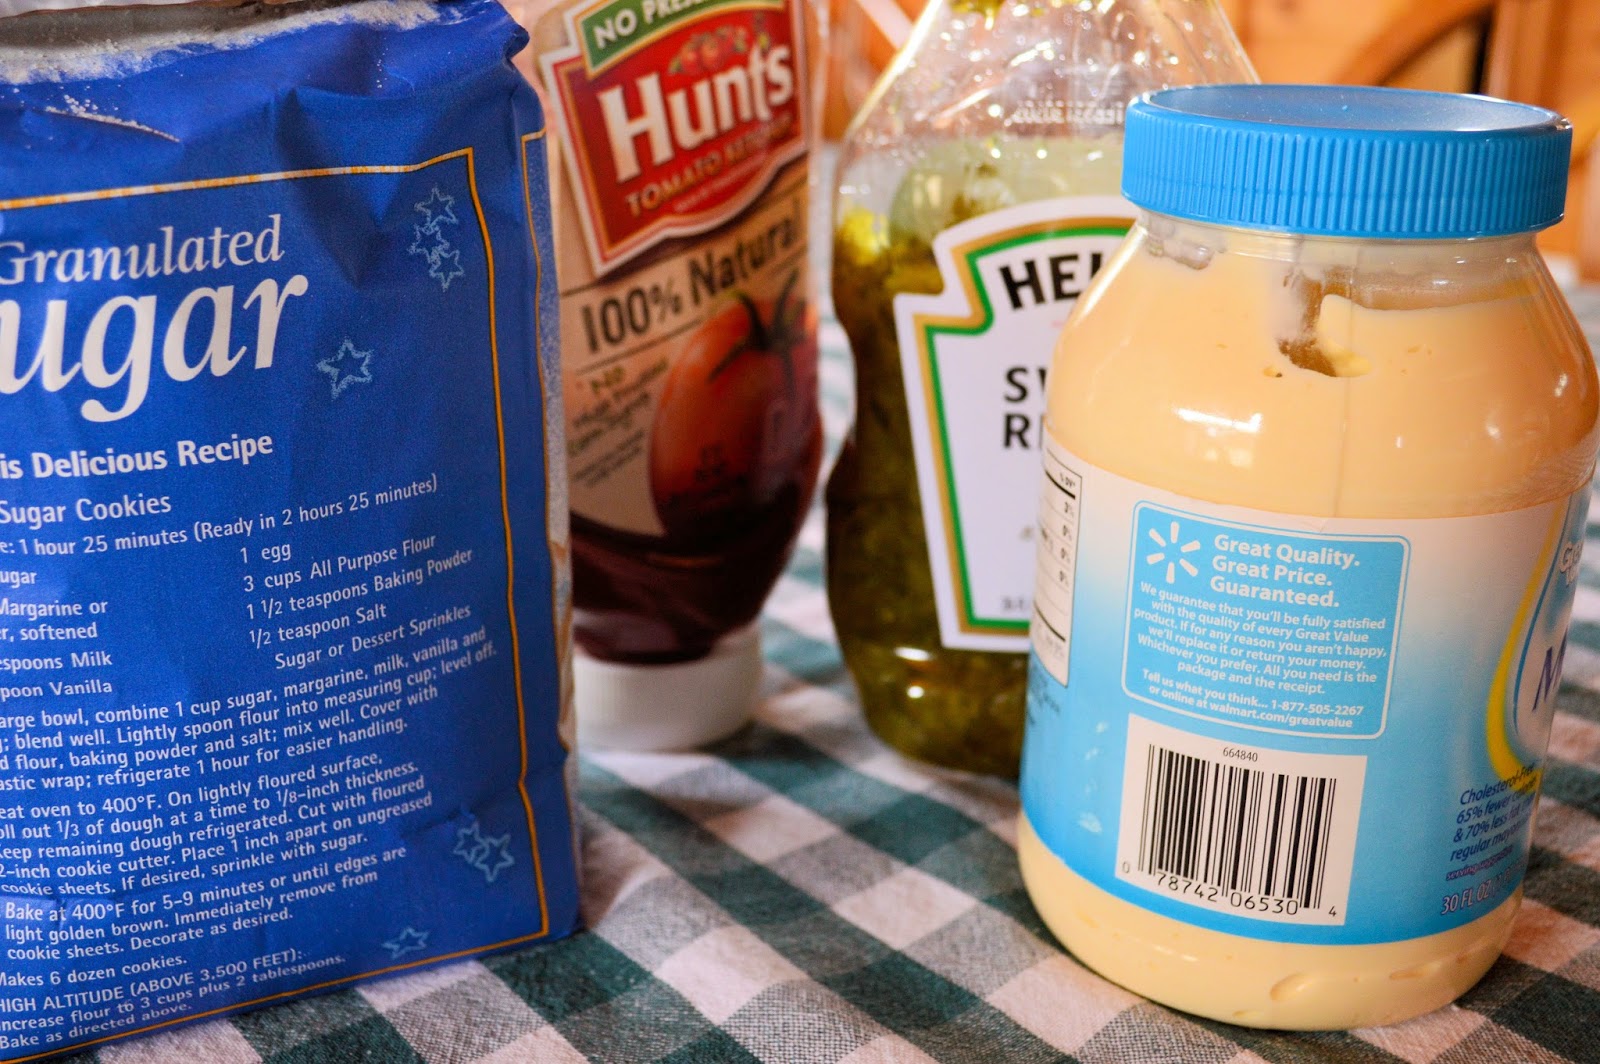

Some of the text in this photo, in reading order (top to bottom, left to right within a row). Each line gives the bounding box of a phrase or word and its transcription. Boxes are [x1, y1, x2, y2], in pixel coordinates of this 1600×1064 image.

[593, 8, 637, 49] NO
[0, 214, 285, 285] Granulated
[580, 276, 683, 352] 100%
[31, 448, 167, 478] Delicious
[177, 434, 273, 466] Recipe
[0, 493, 171, 530] Sugar Cookies
[19, 473, 437, 555] 1 hour 25 minutes (Ready in 2 hours 25 minutes)
[240, 544, 291, 563] 1 egg
[243, 536, 435, 592] 3 cups All Purpose Flour
[1212, 555, 1332, 586] Great Price.
[1214, 534, 1360, 570] Great Quality.
[247, 604, 254, 619] 1
[289, 583, 368, 611] teaspoons
[374, 569, 423, 591] Baking
[427, 550, 472, 575] Powder
[1210, 576, 1339, 607] Guaranteed.
[0, 598, 108, 621] Margarine or
[278, 616, 350, 641] teaspoon
[356, 604, 386, 624] Salt
[1140, 581, 1157, 596] We
[1158, 589, 1217, 612] guarantee
[1219, 603, 1243, 616] that
[1284, 613, 1299, 624] be
[1303, 615, 1331, 629] fully
[1334, 618, 1386, 629] satisfied
[1151, 600, 1369, 642] with the quality of every Great Value
[20, 622, 98, 640] softened
[275, 606, 470, 669] Sugar or Dessert Sprinkles
[1135, 609, 1386, 658] product. If for any reason you aren't happy,
[71, 651, 112, 667] Milk
[1138, 634, 1377, 682] Whichever you prefer. All you need is the
[1176, 635, 1216, 651] replace
[1220, 644, 1227, 653] it
[1231, 648, 1243, 656] or
[1247, 651, 1284, 663] return
[1289, 657, 1317, 666] your
[1320, 660, 1365, 671] money.
[41, 626, 485, 726] bowl, combine 1 cup sugar, margarine, milk, vanilla and
[49, 679, 112, 695] Vanilla
[1142, 669, 1161, 684] Tell
[1162, 678, 1174, 688] us
[1176, 682, 1203, 695] what
[1204, 689, 1226, 700] you
[1272, 700, 1364, 715] 1-877-505-2267
[1178, 662, 1325, 695] package and the receipt.
[15, 731, 63, 749] blend
[70, 729, 110, 746] well.
[117, 724, 177, 746] Lightly
[184, 718, 233, 739] spoon
[239, 709, 279, 726] flour
[287, 700, 318, 717] into
[325, 679, 401, 708] measuring
[442, 652, 471, 674] level
[1149, 685, 1353, 727] or online at walmart.com/greatvalue
[1222, 746, 1259, 763] 664840
[1456, 805, 1484, 825] 65%
[1485, 795, 1512, 816] fewer
[1465, 820, 1490, 840] 70%
[1450, 839, 1490, 862] regular
[6, 902, 44, 920] Bake
[49, 907, 66, 924] at
[131, 900, 156, 915] for
[200, 881, 264, 902] minutes
[270, 876, 286, 888] or
[293, 863, 328, 882] until
[335, 855, 377, 872] edges
[383, 847, 406, 861] are
[1121, 861, 1338, 918] 0 78742 06530 4
[1441, 893, 1460, 916] 30
[43, 986, 123, 1009] ALTITUDE
[130, 972, 194, 996] (ABOVE
